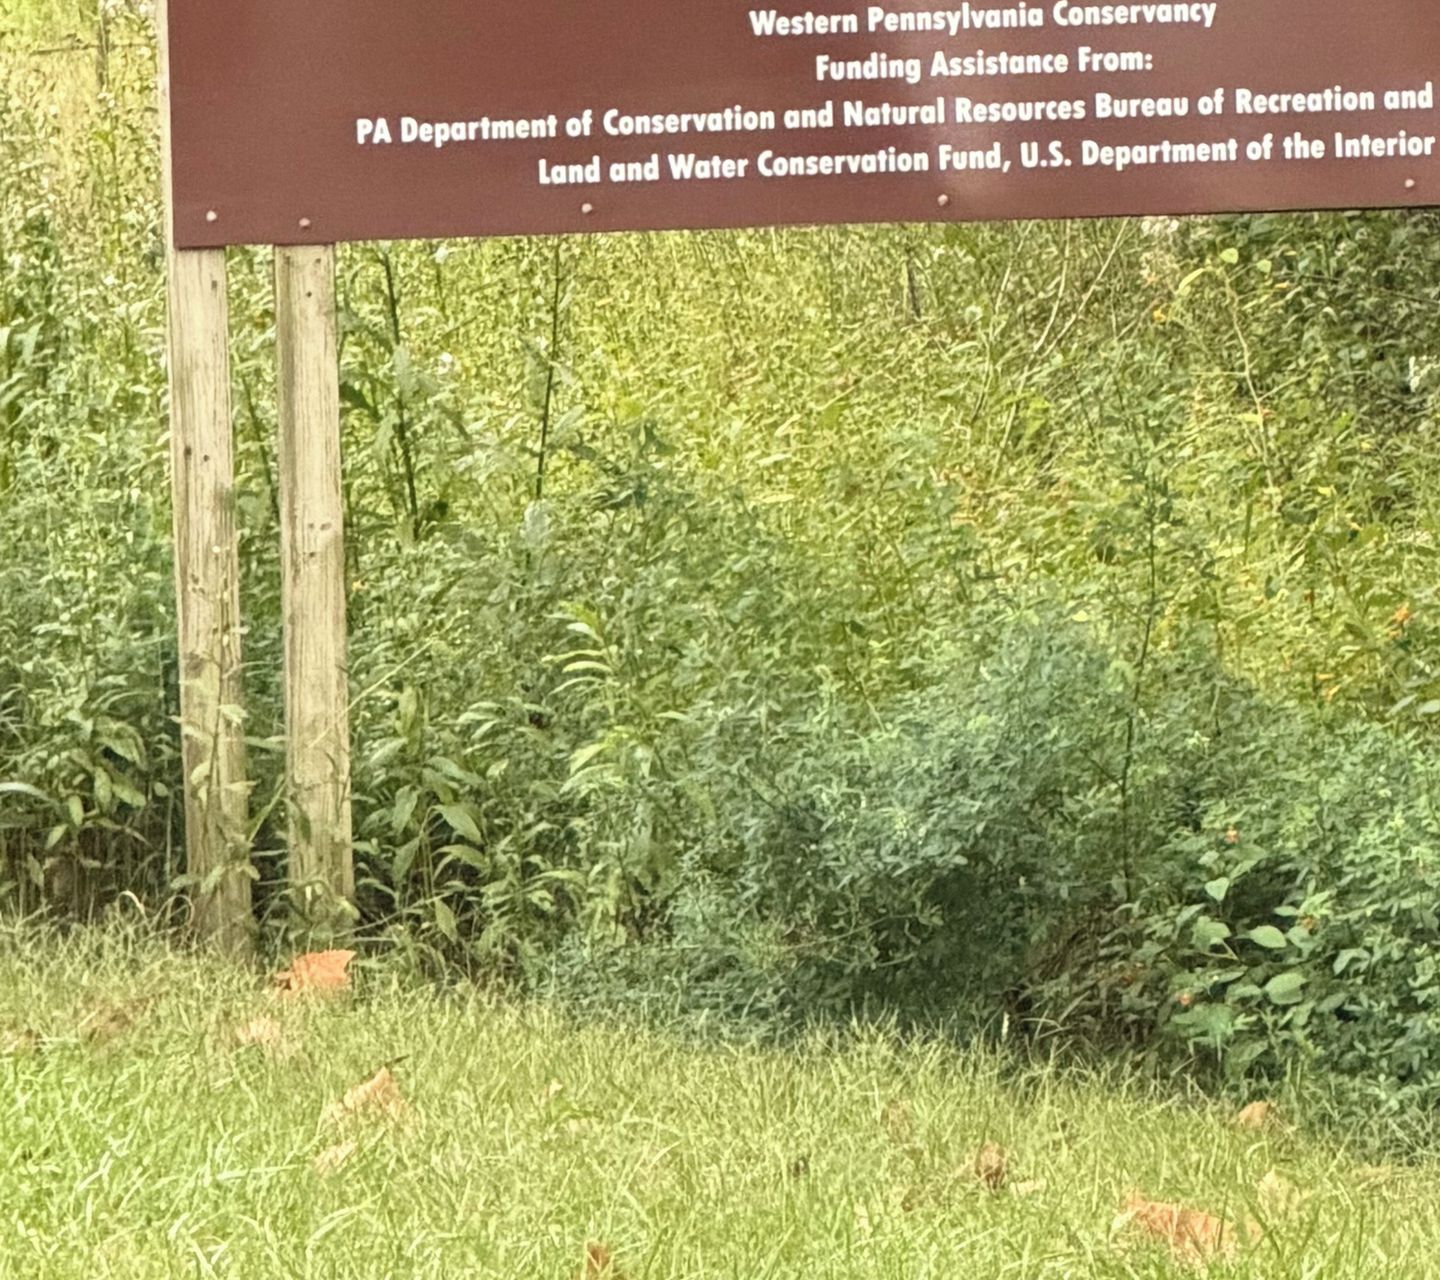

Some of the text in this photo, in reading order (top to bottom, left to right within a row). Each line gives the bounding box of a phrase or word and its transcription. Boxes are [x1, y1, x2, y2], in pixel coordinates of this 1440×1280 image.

[748, 0, 1217, 37] Western Pennsylvania Conservancy
[815, 45, 1153, 85] Funding Assistance From:
[356, 117, 393, 145] PA
[400, 114, 558, 149] Department
[565, 108, 593, 138] of
[602, 104, 776, 136] Conservation
[783, 99, 834, 130] and
[843, 96, 945, 128] Natural
[955, 97, 1086, 123] Resources
[1094, 92, 1189, 119] Bureau
[1197, 87, 1225, 116] of
[1235, 84, 1375, 114] Recreation
[1383, 80, 1434, 110] and
[538, 129, 1436, 185] Land and Water Conservation Fund, U.S. Department of the Interior
